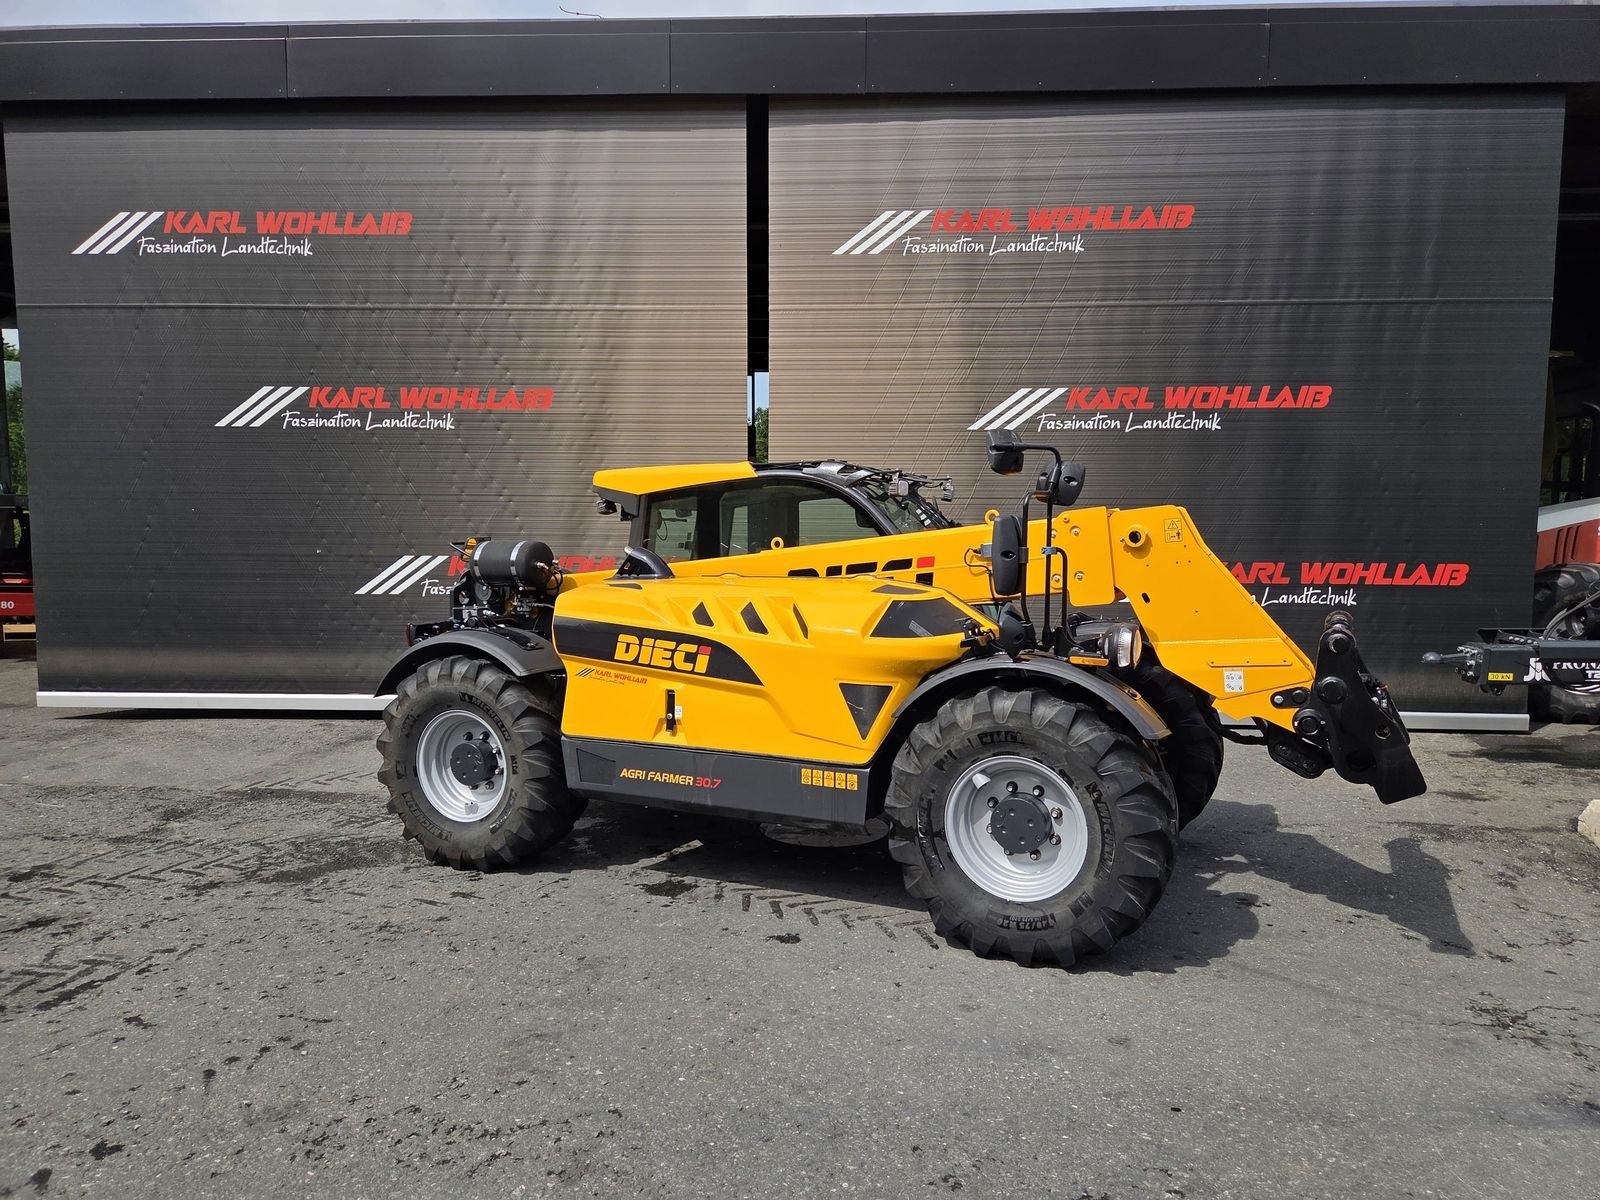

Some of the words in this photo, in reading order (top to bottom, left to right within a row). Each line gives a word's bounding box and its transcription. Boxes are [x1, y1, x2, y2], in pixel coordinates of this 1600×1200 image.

[163, 211, 247, 235] KARL
[931, 208, 1018, 233] KARL
[137, 236, 217, 257] Faszination
[221, 236, 313, 257] Landtechnik
[902, 235, 984, 257] Faszination
[989, 233, 1086, 257] Landtechnik
[308, 387, 392, 409] KARL
[1066, 387, 1155, 410] KARL
[281, 410, 361, 430] Faszination
[365, 411, 455, 431] Landtechnik
[1036, 412, 1121, 433] Faszination
[1125, 411, 1222, 433] Landtechnik
[1223, 562, 1291, 586] ARL
[1261, 587, 1357, 607] Landtechnik
[472, 695, 512, 742] MICHELIN
[620, 768, 646, 780] AGRI
[647, 771, 694, 786] FARMER
[695, 776, 721, 789] 30.7
